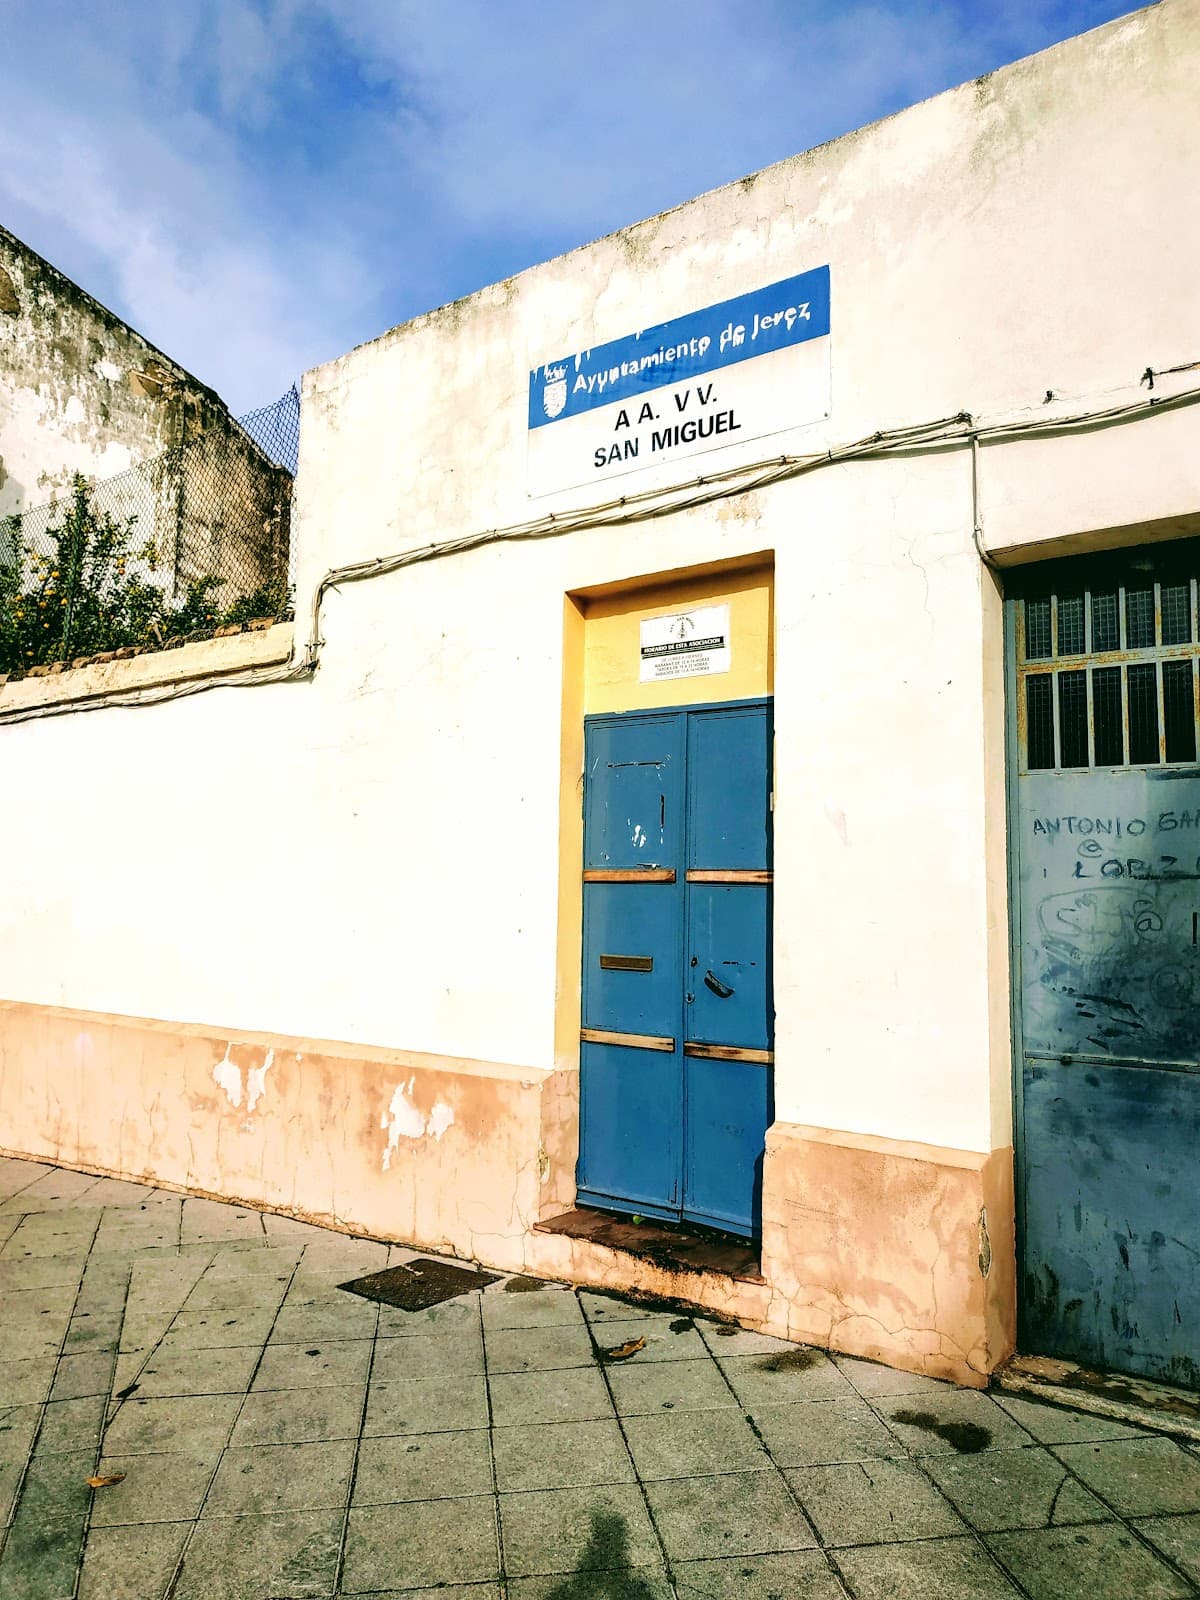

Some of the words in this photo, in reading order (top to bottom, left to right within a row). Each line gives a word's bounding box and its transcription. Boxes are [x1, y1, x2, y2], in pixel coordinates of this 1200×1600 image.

[573, 335, 711, 393] Ayuntamiento
[720, 322, 746, 353] de
[751, 301, 811, 342] Jerez
[593, 437, 640, 468] SAN
[651, 409, 742, 452] MIGUEL
[1033, 816, 1146, 838] ANTONIO
